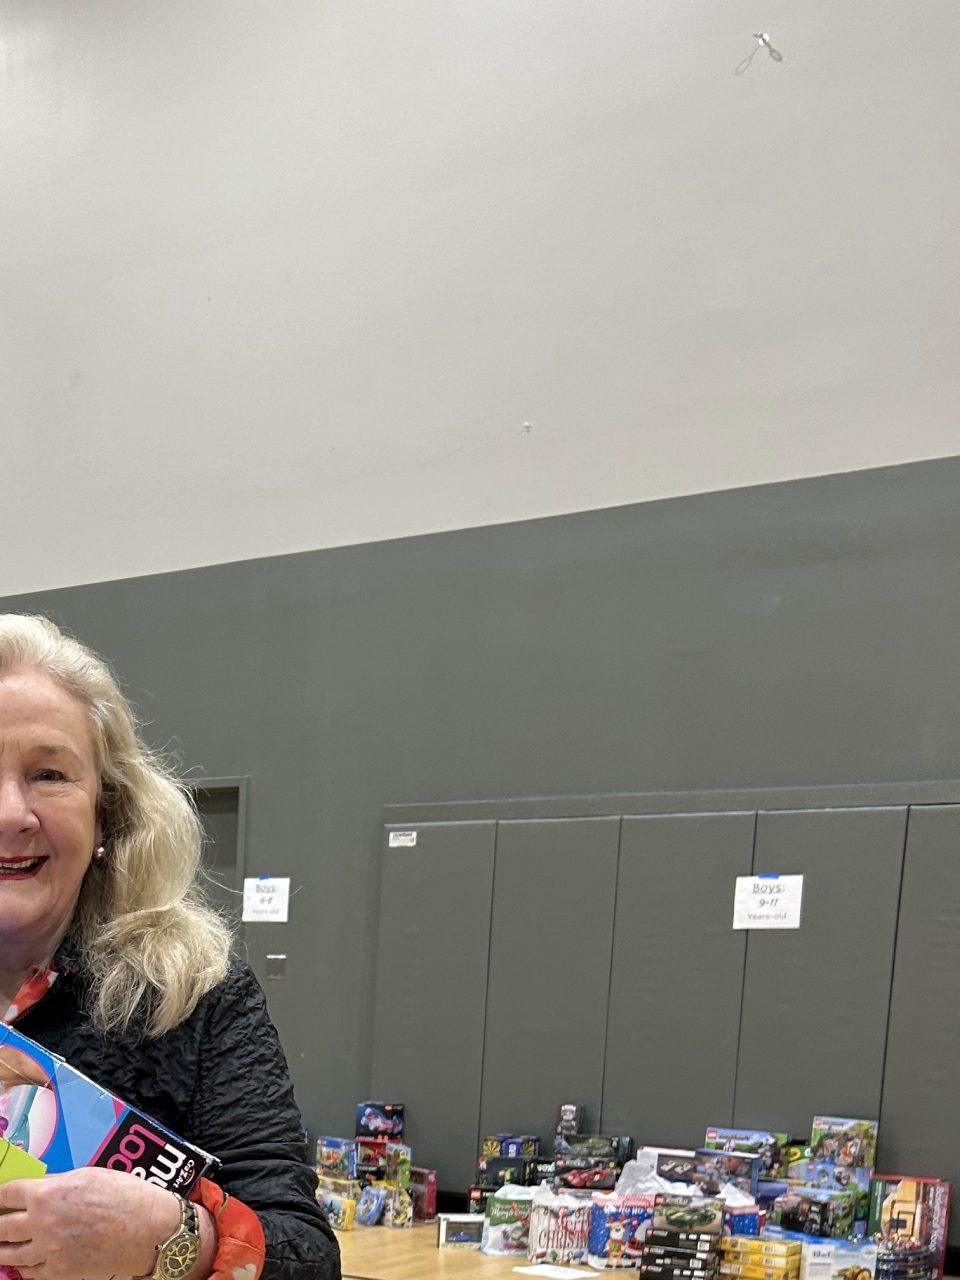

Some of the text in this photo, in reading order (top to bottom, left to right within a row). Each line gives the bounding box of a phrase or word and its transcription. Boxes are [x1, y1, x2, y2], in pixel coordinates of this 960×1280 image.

[753, 883, 785, 895] Boys:
[759, 898, 778, 908] 9-11
[107, 1123, 165, 1172] loo
